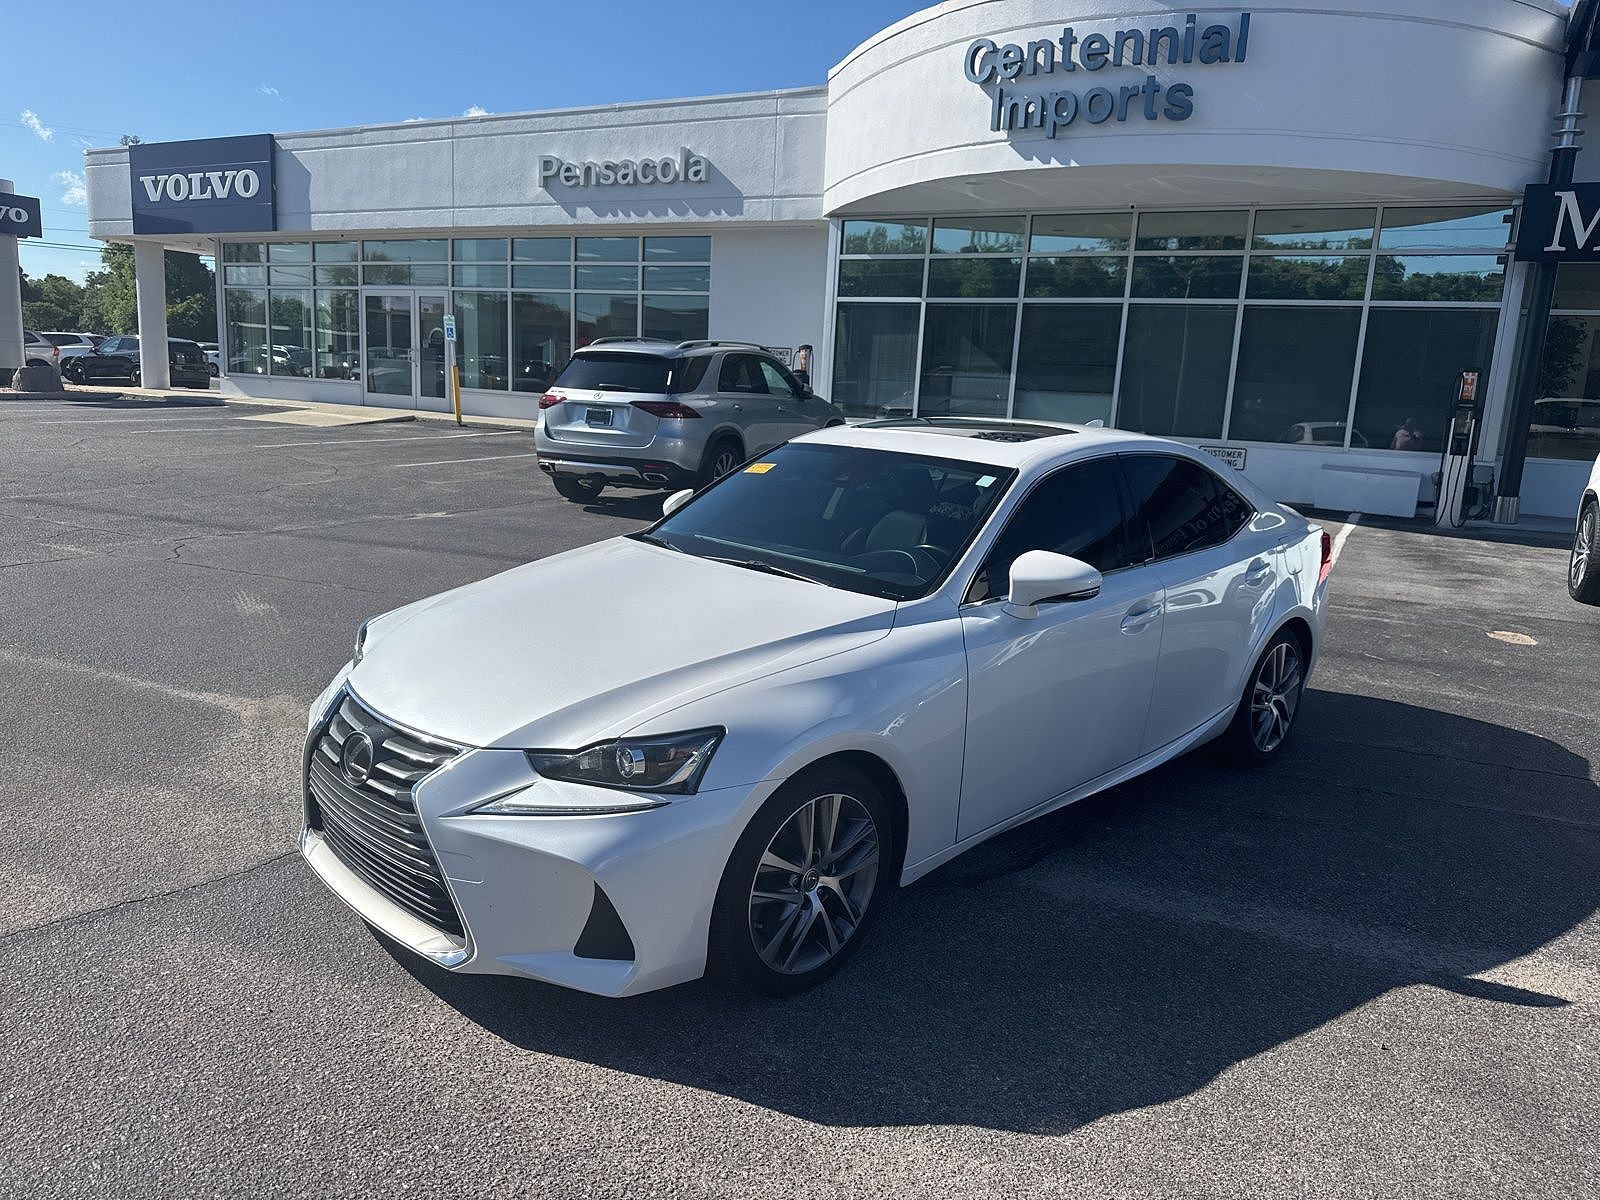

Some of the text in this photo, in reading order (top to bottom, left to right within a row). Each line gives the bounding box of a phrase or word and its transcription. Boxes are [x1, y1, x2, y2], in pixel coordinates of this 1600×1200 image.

[964, 13, 1250, 84] Centennial
[990, 75, 1194, 139] Imports
[139, 169, 260, 202] VOLVO
[537, 147, 710, 188] Pensacola
[1203, 449, 1242, 458] STOMER
